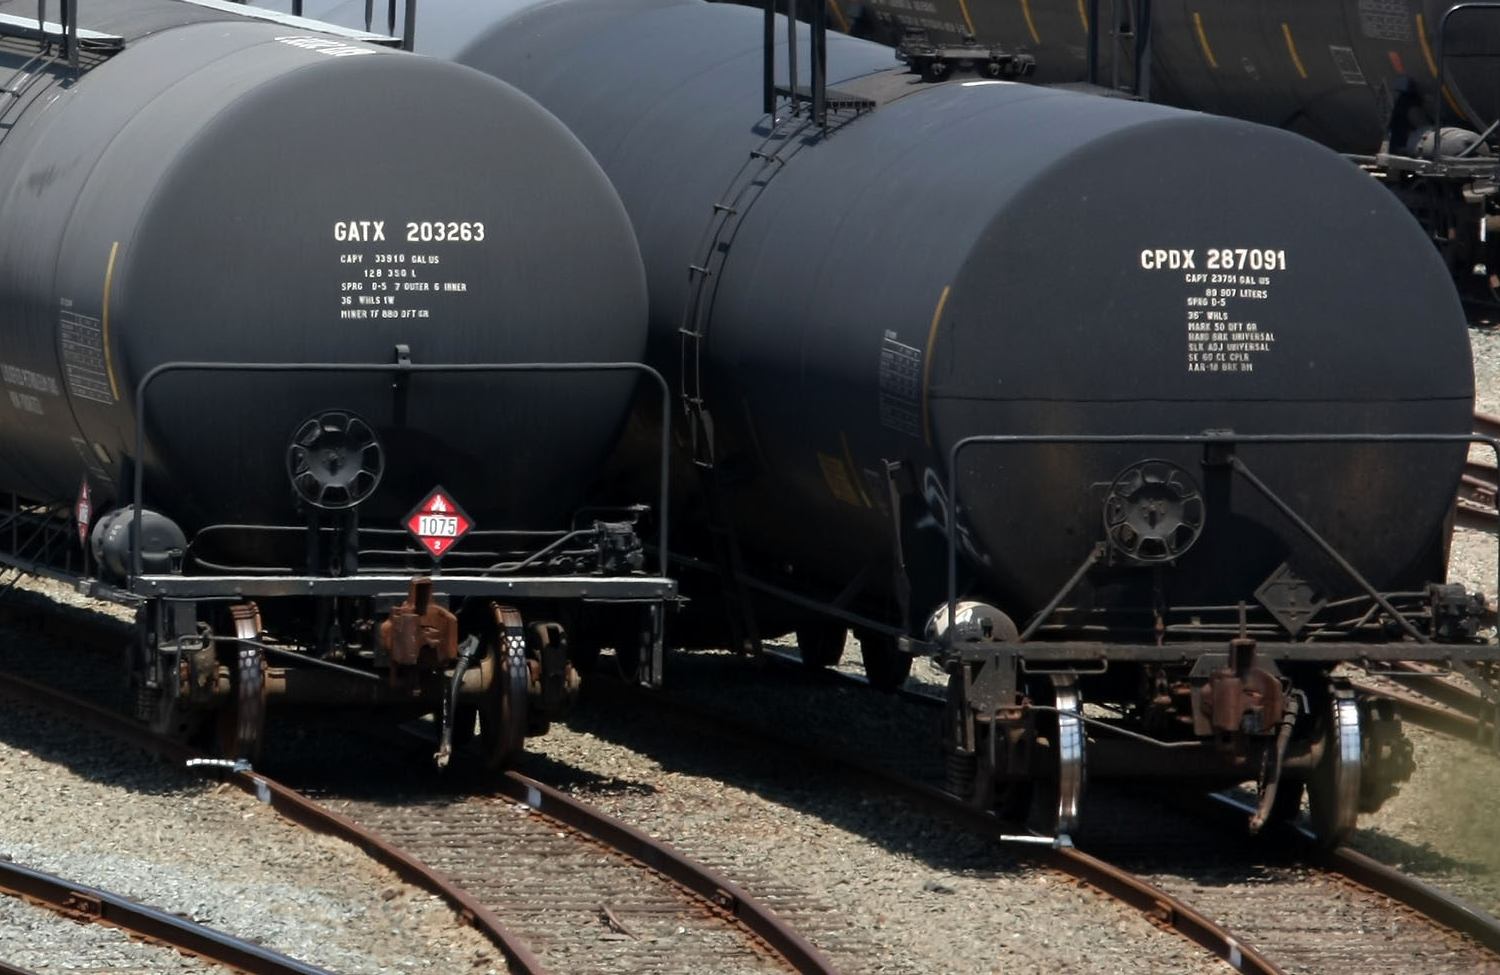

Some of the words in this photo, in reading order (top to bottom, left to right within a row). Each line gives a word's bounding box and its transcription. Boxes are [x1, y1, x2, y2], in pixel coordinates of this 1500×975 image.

[334, 221, 386, 241] GATX
[406, 222, 485, 242] 203263
[340, 254, 363, 263] CAPY
[411, 255, 426, 263] GAL
[429, 256, 440, 264] US
[1141, 249, 1195, 269] CPDX
[1207, 249, 1286, 270] 287091
[364, 269, 382, 277] 128
[411, 270, 416, 278] L
[1186, 274, 1207, 282] CAPY
[1239, 276, 1256, 285] GAL
[341, 283, 363, 291] SPRG
[404, 283, 429, 291] OUTER
[1240, 289, 1268, 299] LITERS
[341, 297, 352, 305] 36
[1211, 298, 1226, 306] D-5
[1207, 311, 1228, 320] WHLS
[1188, 323, 1211, 331] MARK
[1232, 333, 1276, 341] UNIVERSAL
[1227, 343, 1270, 351] UNIVERSAL
[422, 518, 456, 535] 1075
[434, 541, 441, 549] 2
